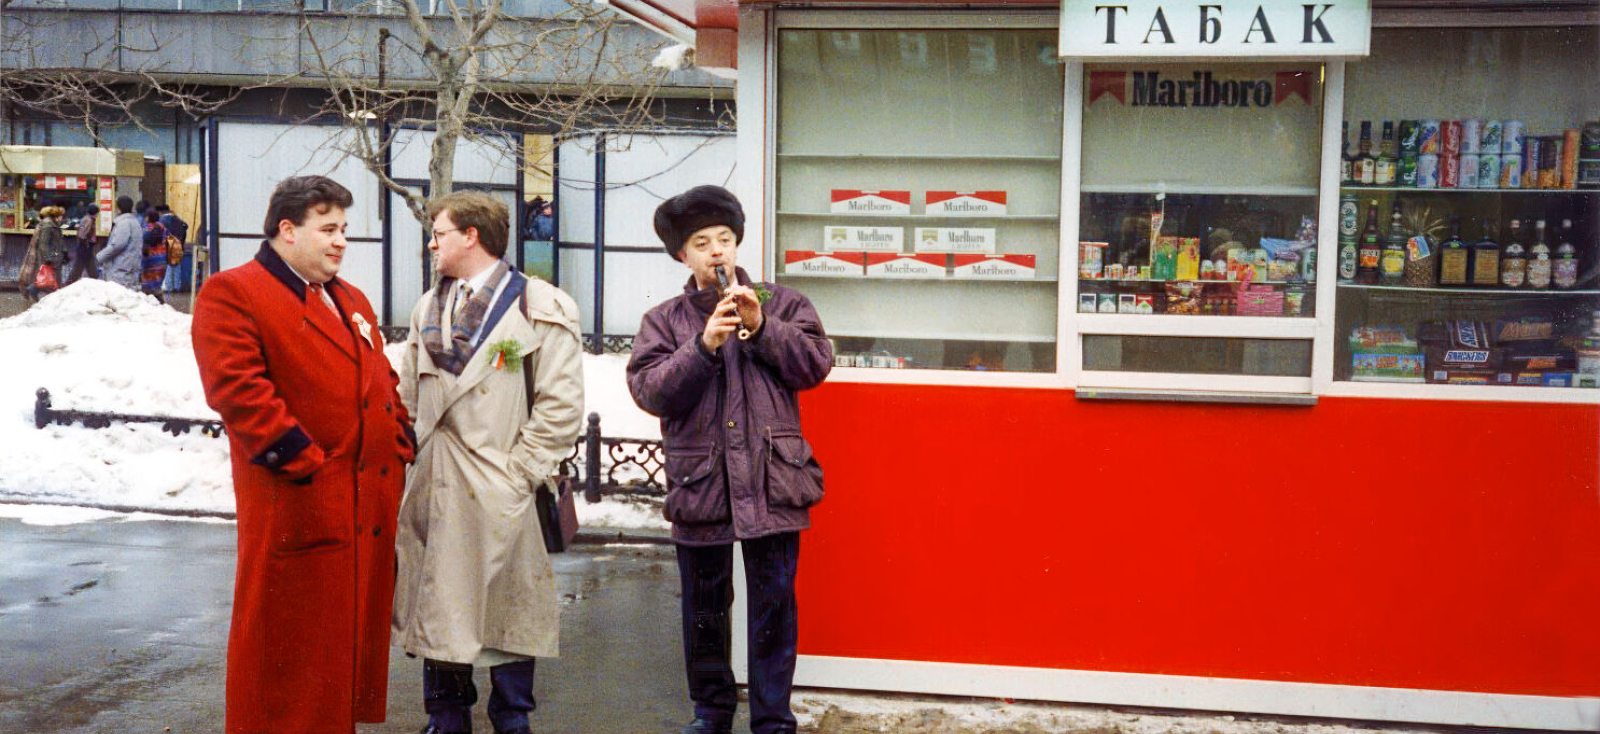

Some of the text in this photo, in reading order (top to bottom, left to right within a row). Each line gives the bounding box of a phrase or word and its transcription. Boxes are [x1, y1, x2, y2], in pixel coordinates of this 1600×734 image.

[1095, 4, 1335, 43] ТАБАК
[1131, 71, 1273, 107] Marlboro
[848, 200, 892, 212] Marlboro
[943, 201, 988, 213] Marlboro
[857, 229, 893, 242] Marlboro
[948, 230, 985, 243] Marlboro
[802, 262, 845, 273] Marlboro
[884, 263, 928, 275] Marlboro
[971, 264, 1017, 276] Marlboro
